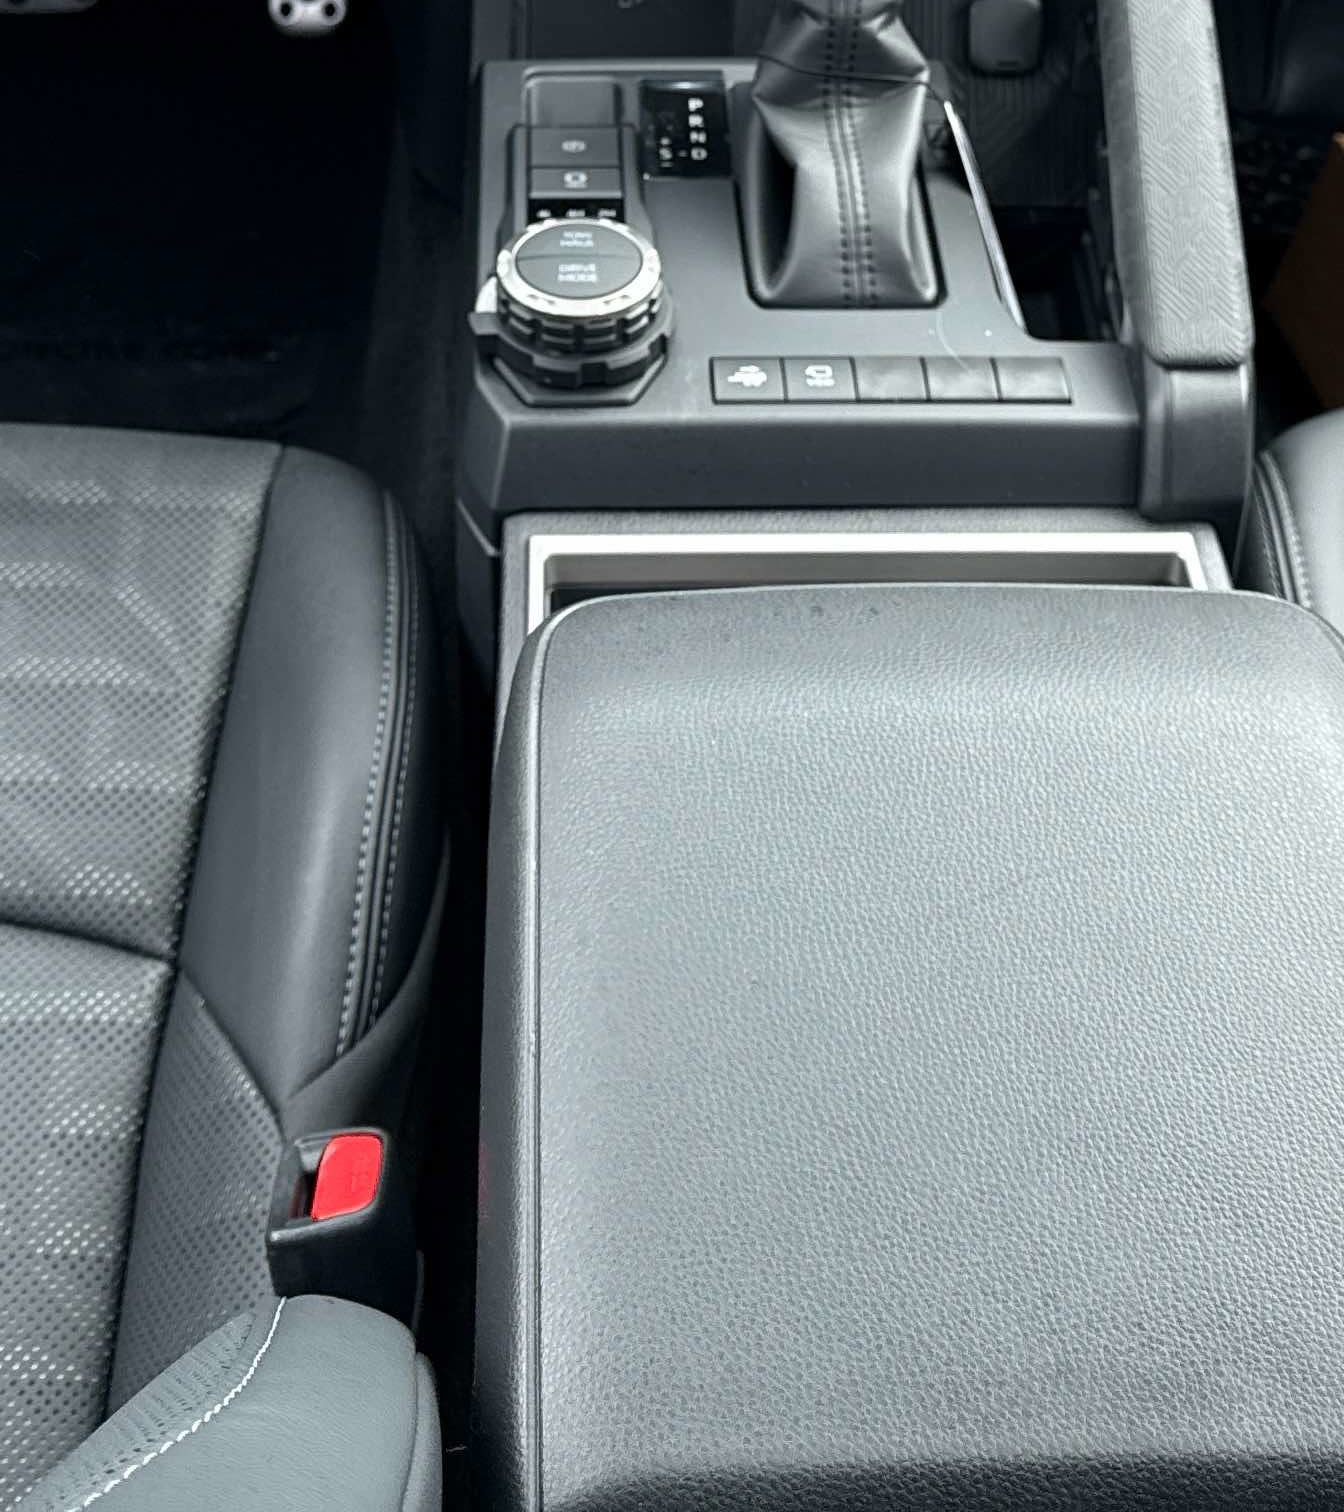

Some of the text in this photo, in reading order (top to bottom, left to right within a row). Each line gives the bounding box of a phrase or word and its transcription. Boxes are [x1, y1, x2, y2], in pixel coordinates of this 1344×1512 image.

[688, 97, 704, 112] P
[689, 131, 707, 144] N
[691, 147, 708, 161] D
